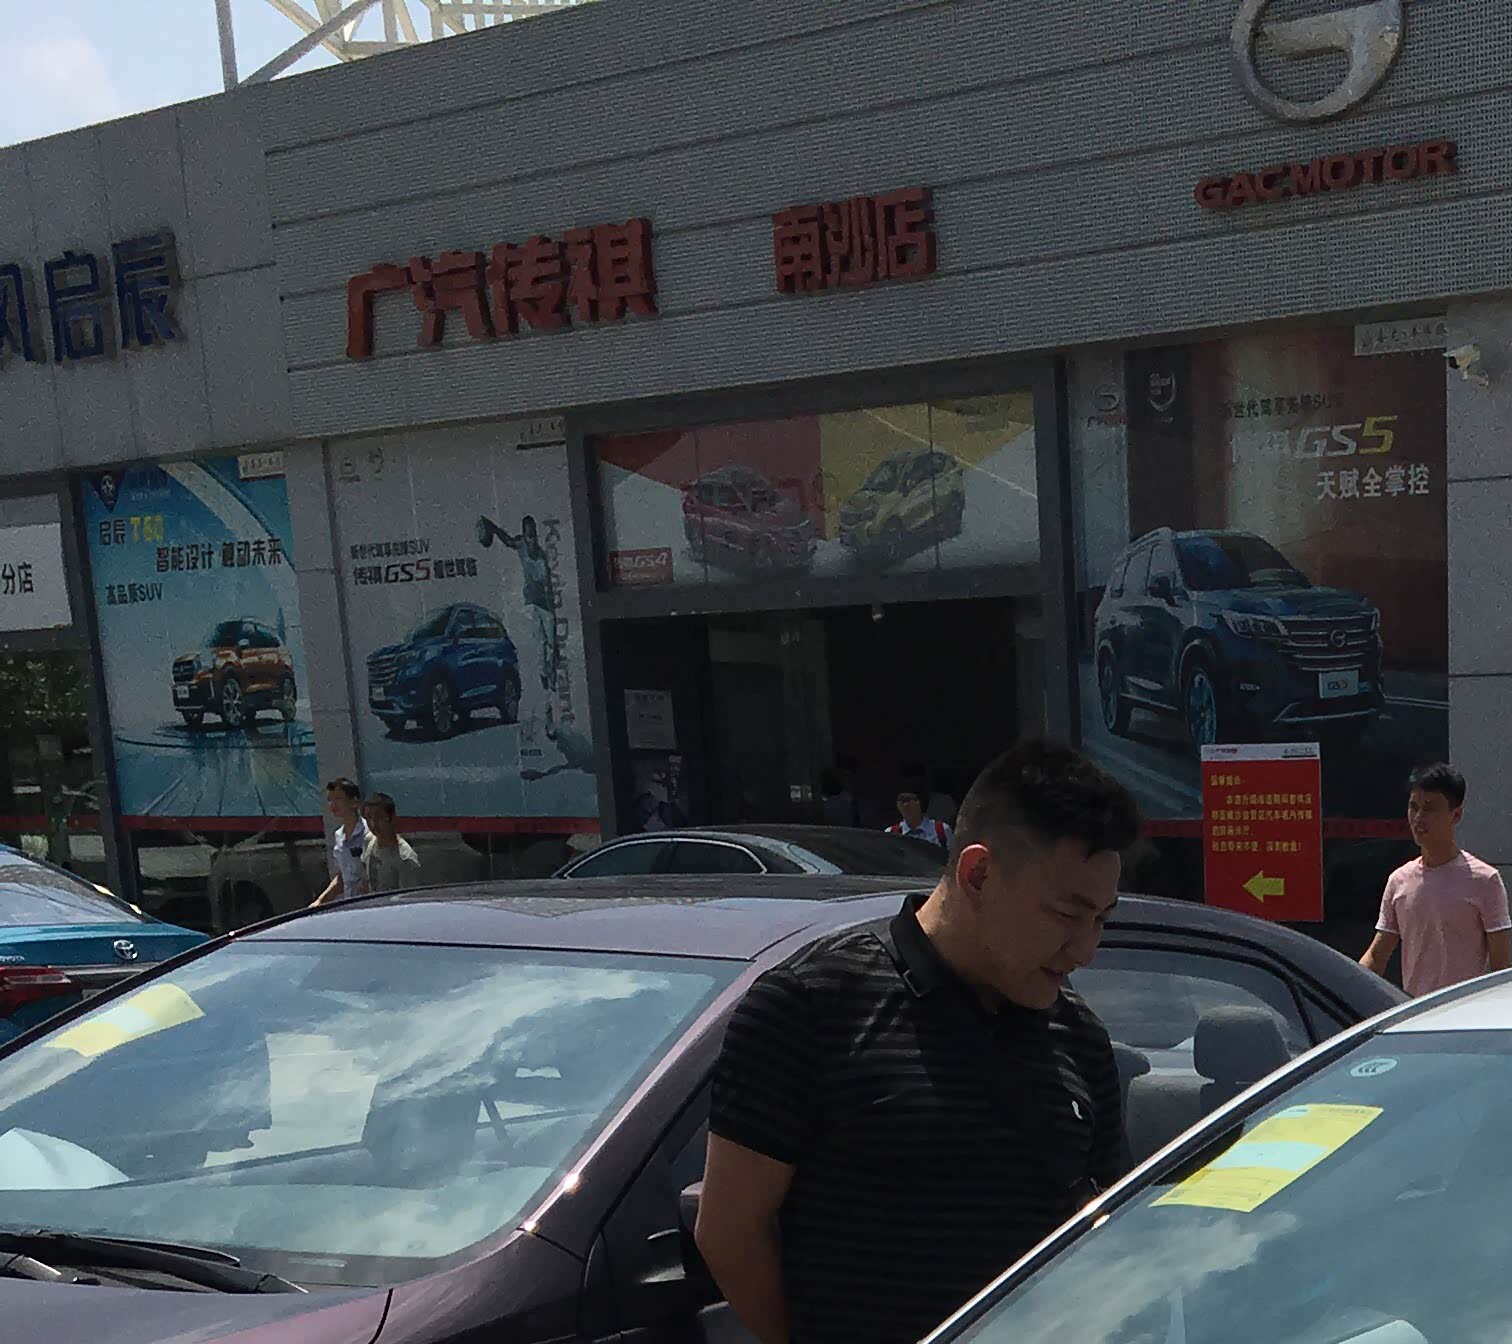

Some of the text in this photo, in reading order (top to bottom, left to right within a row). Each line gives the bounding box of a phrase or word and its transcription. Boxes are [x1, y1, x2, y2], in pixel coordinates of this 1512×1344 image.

[772, 186, 936, 294] 南沙店
[346, 217, 662, 362] 广汽传祺
[1317, 463, 1430, 501] 天赋全掌控
[1, 562, 35, 596] 分店
